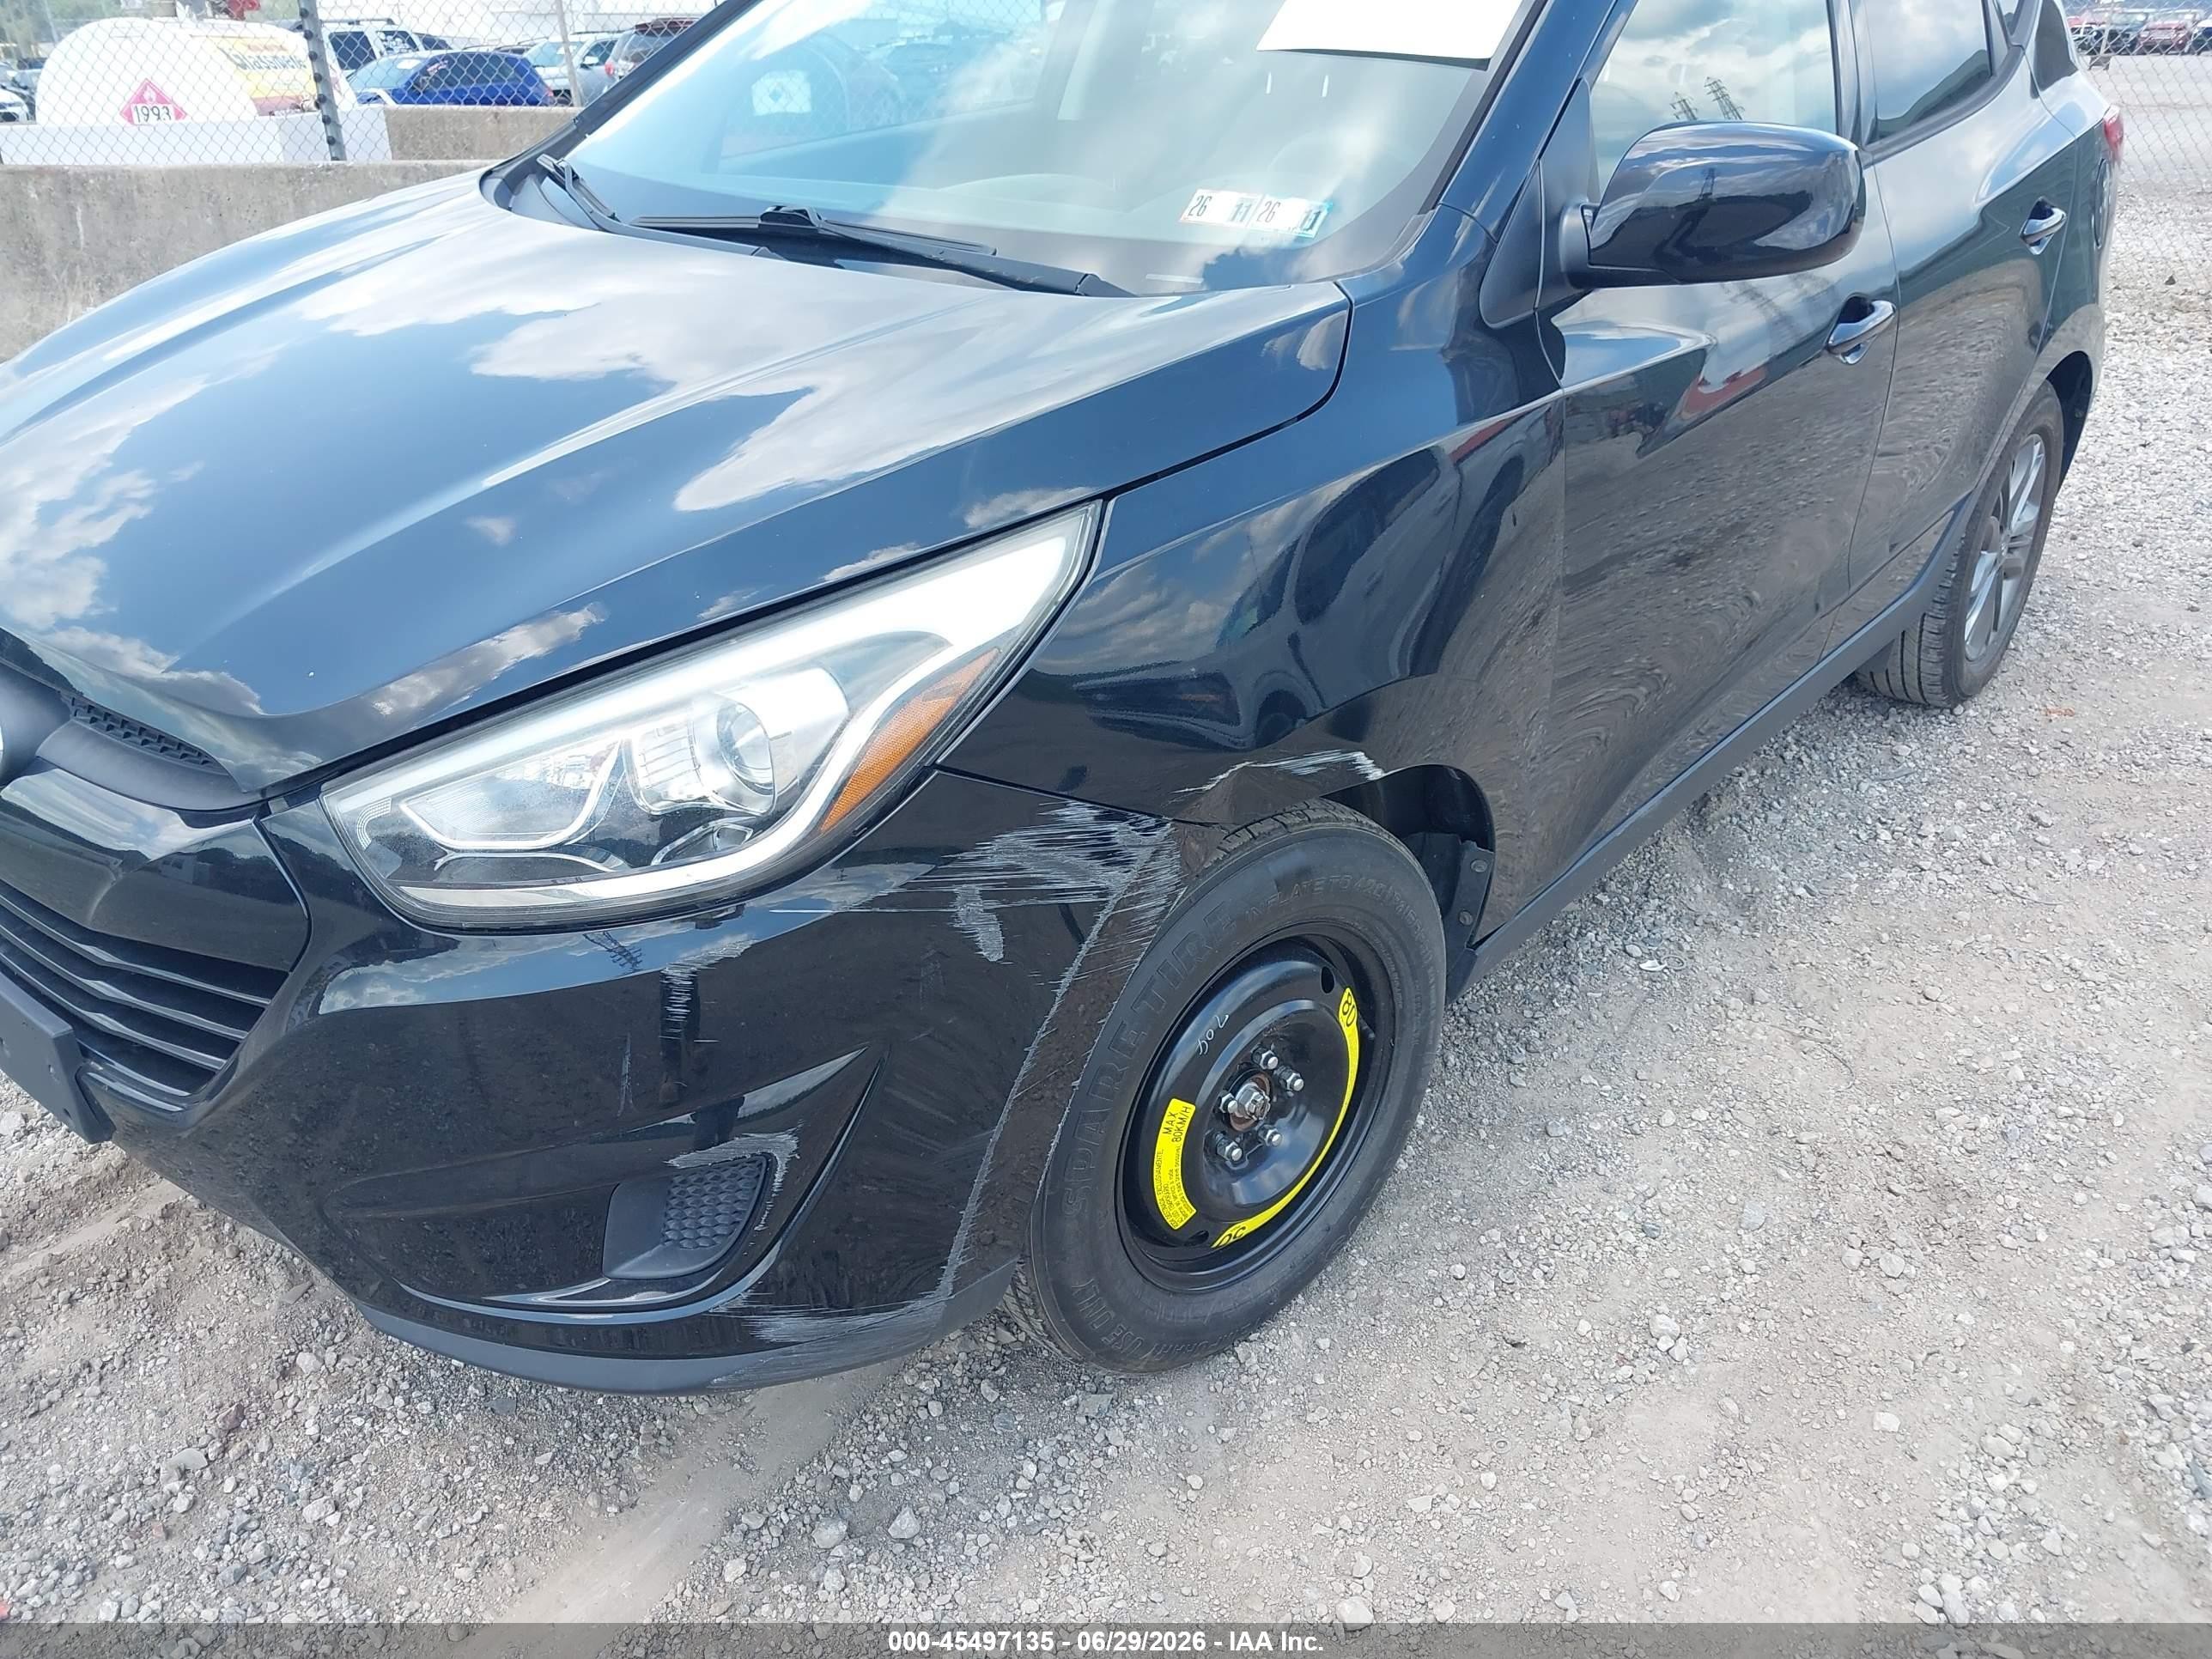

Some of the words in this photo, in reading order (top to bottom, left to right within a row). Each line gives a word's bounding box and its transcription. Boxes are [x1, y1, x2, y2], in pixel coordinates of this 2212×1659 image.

[134, 105, 172, 123] 1993
[1188, 195, 1212, 217] 26
[1257, 201, 1280, 222] 26
[1342, 992, 1356, 1027] 80
[1061, 1019, 1146, 1217] SPARE
[1131, 902, 1237, 1015] TIRE
[1163, 1111, 1177, 1135] MAX
[1172, 1106, 1192, 1143] 80KM/H
[1071, 1278, 1115, 1329] ONLY
[1101, 1323, 1146, 1352] USE
